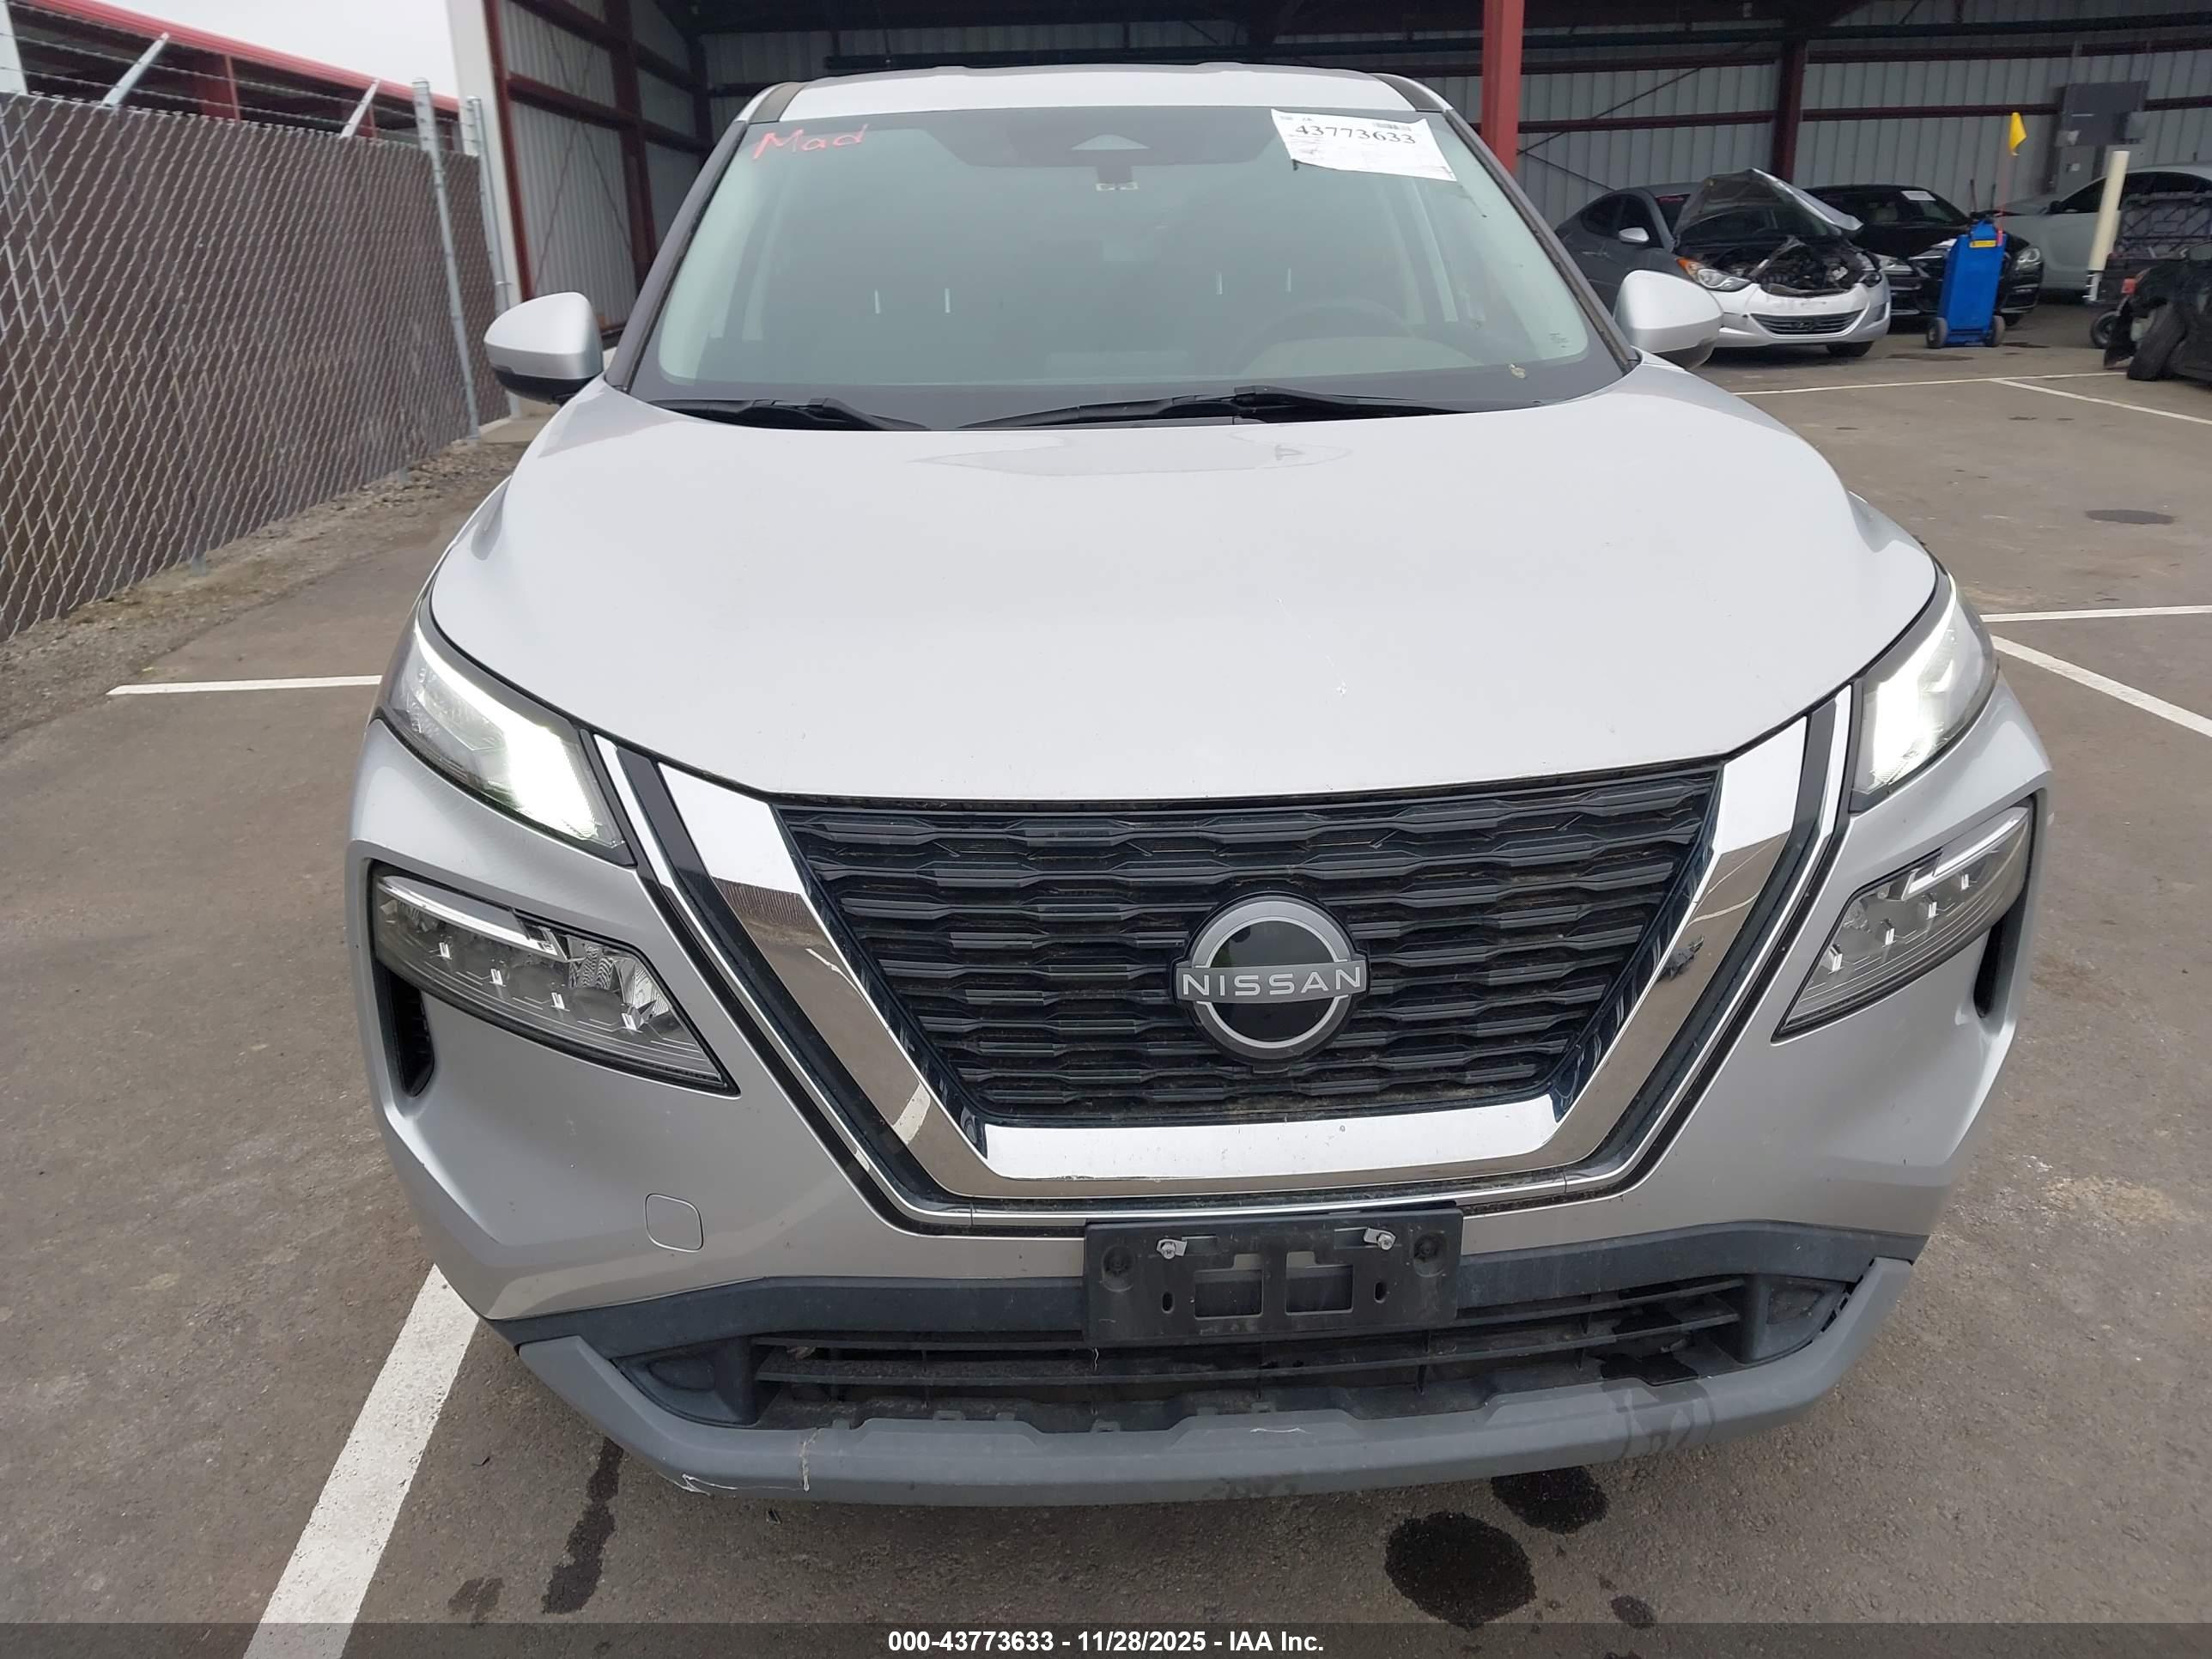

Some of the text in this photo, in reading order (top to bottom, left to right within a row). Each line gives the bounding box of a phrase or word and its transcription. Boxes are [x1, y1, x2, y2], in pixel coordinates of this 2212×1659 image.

[752, 124, 869, 161] Mad
[1295, 125, 1416, 144] 43773633
[1182, 967, 1361, 996] NISSAN
